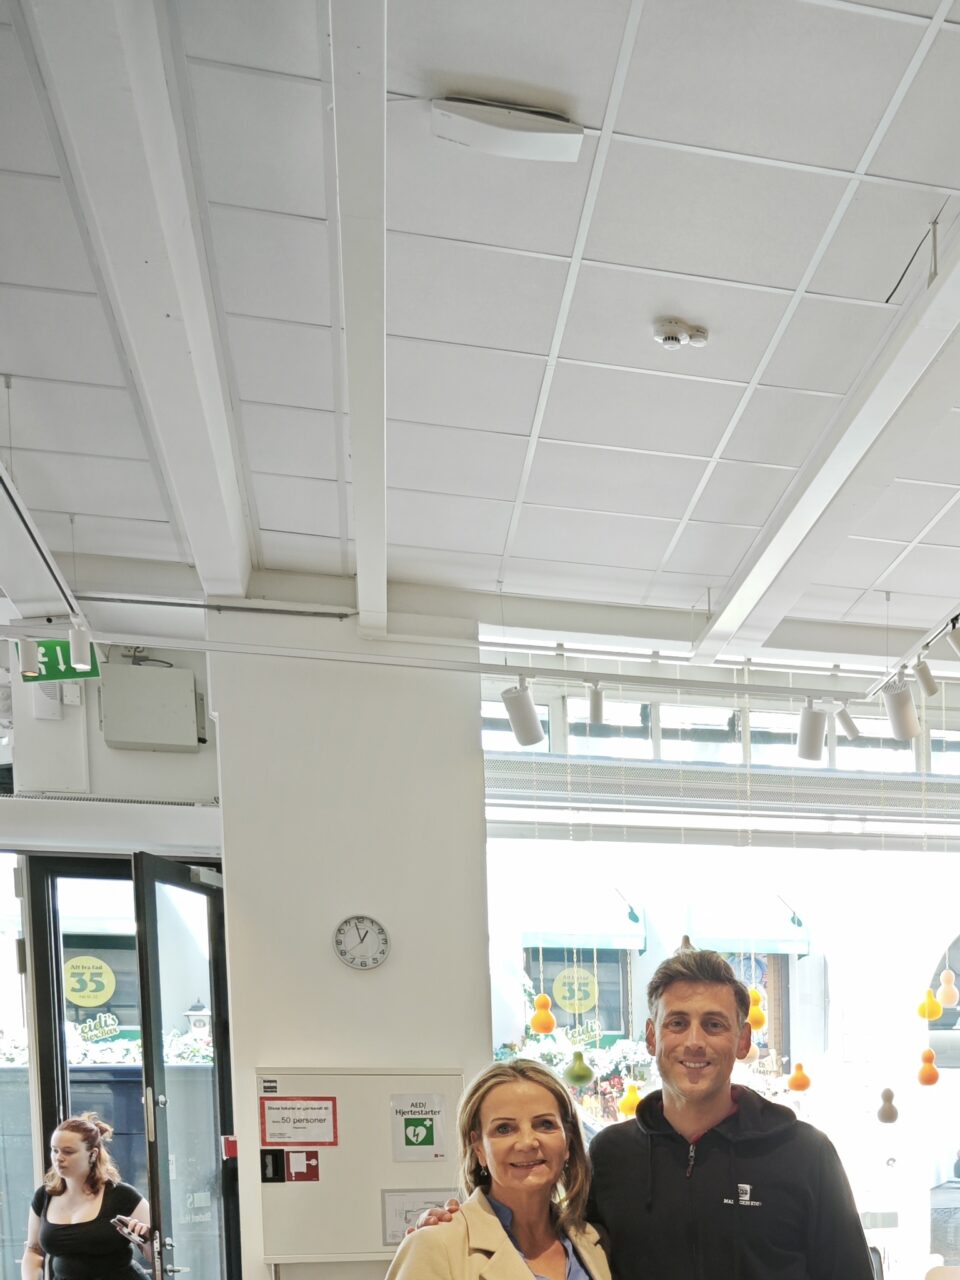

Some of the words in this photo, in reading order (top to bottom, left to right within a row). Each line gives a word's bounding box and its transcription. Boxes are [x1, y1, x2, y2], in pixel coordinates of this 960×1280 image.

[70, 972, 105, 993] 35
[562, 982, 590, 1000] 35
[410, 1101, 427, 1109] AED/
[395, 1109, 441, 1117] Hjertestarter
[281, 1116, 291, 1124] 50
[293, 1116, 327, 1124] personer
